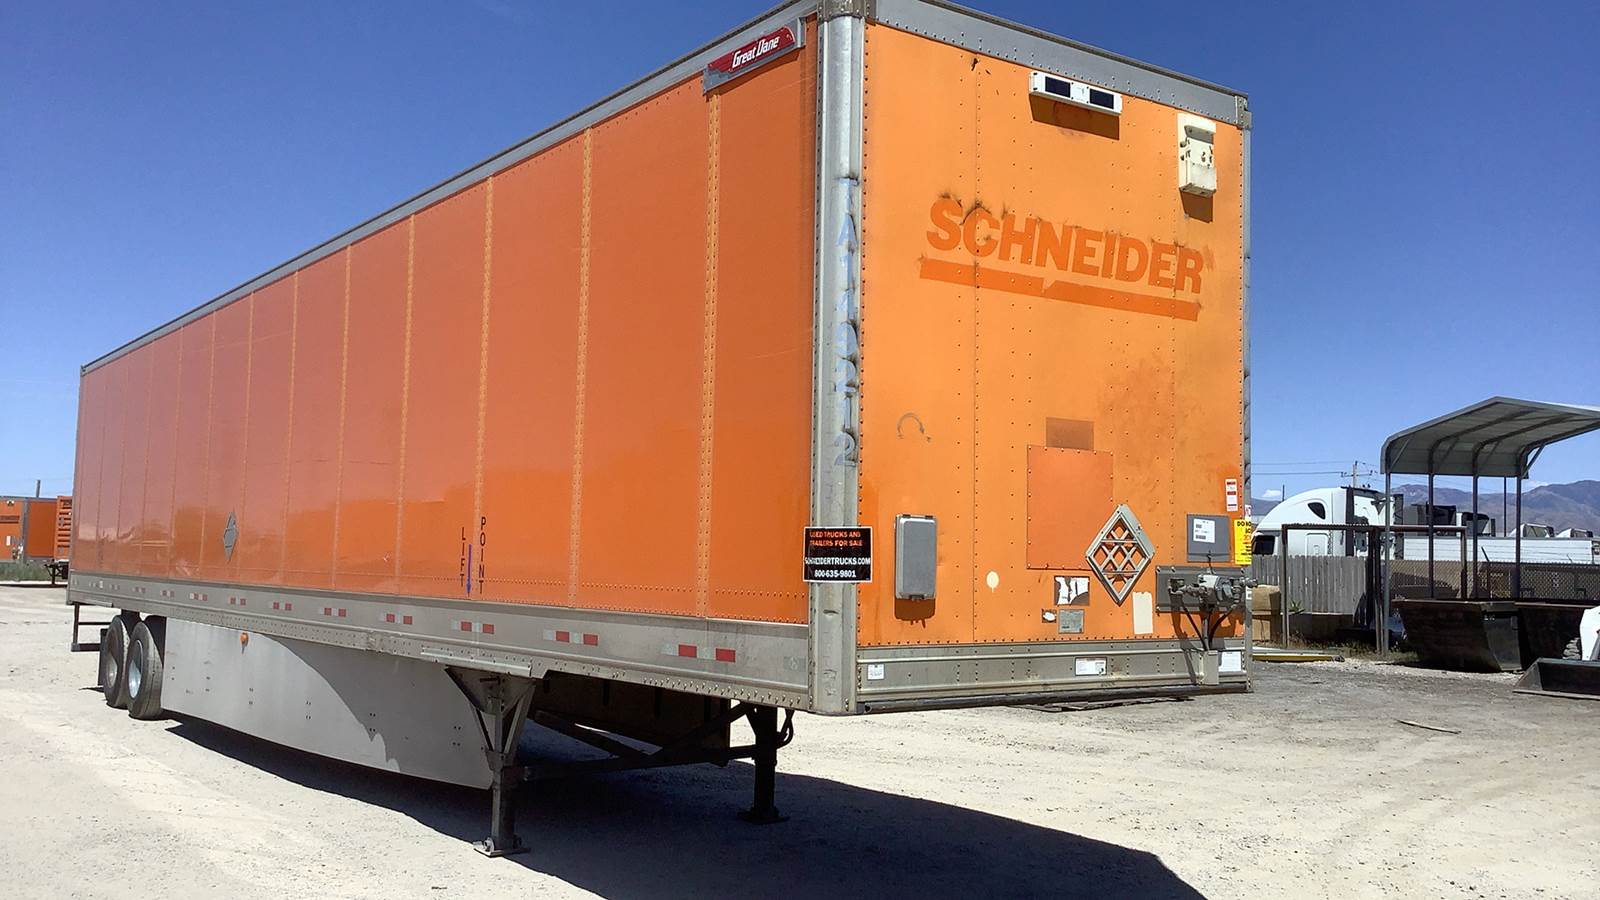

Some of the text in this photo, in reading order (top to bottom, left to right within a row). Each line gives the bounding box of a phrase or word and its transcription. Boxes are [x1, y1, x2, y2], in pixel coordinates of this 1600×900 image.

[732, 36, 780, 68] Great Dane
[926, 195, 1204, 294] SCHNEIDER
